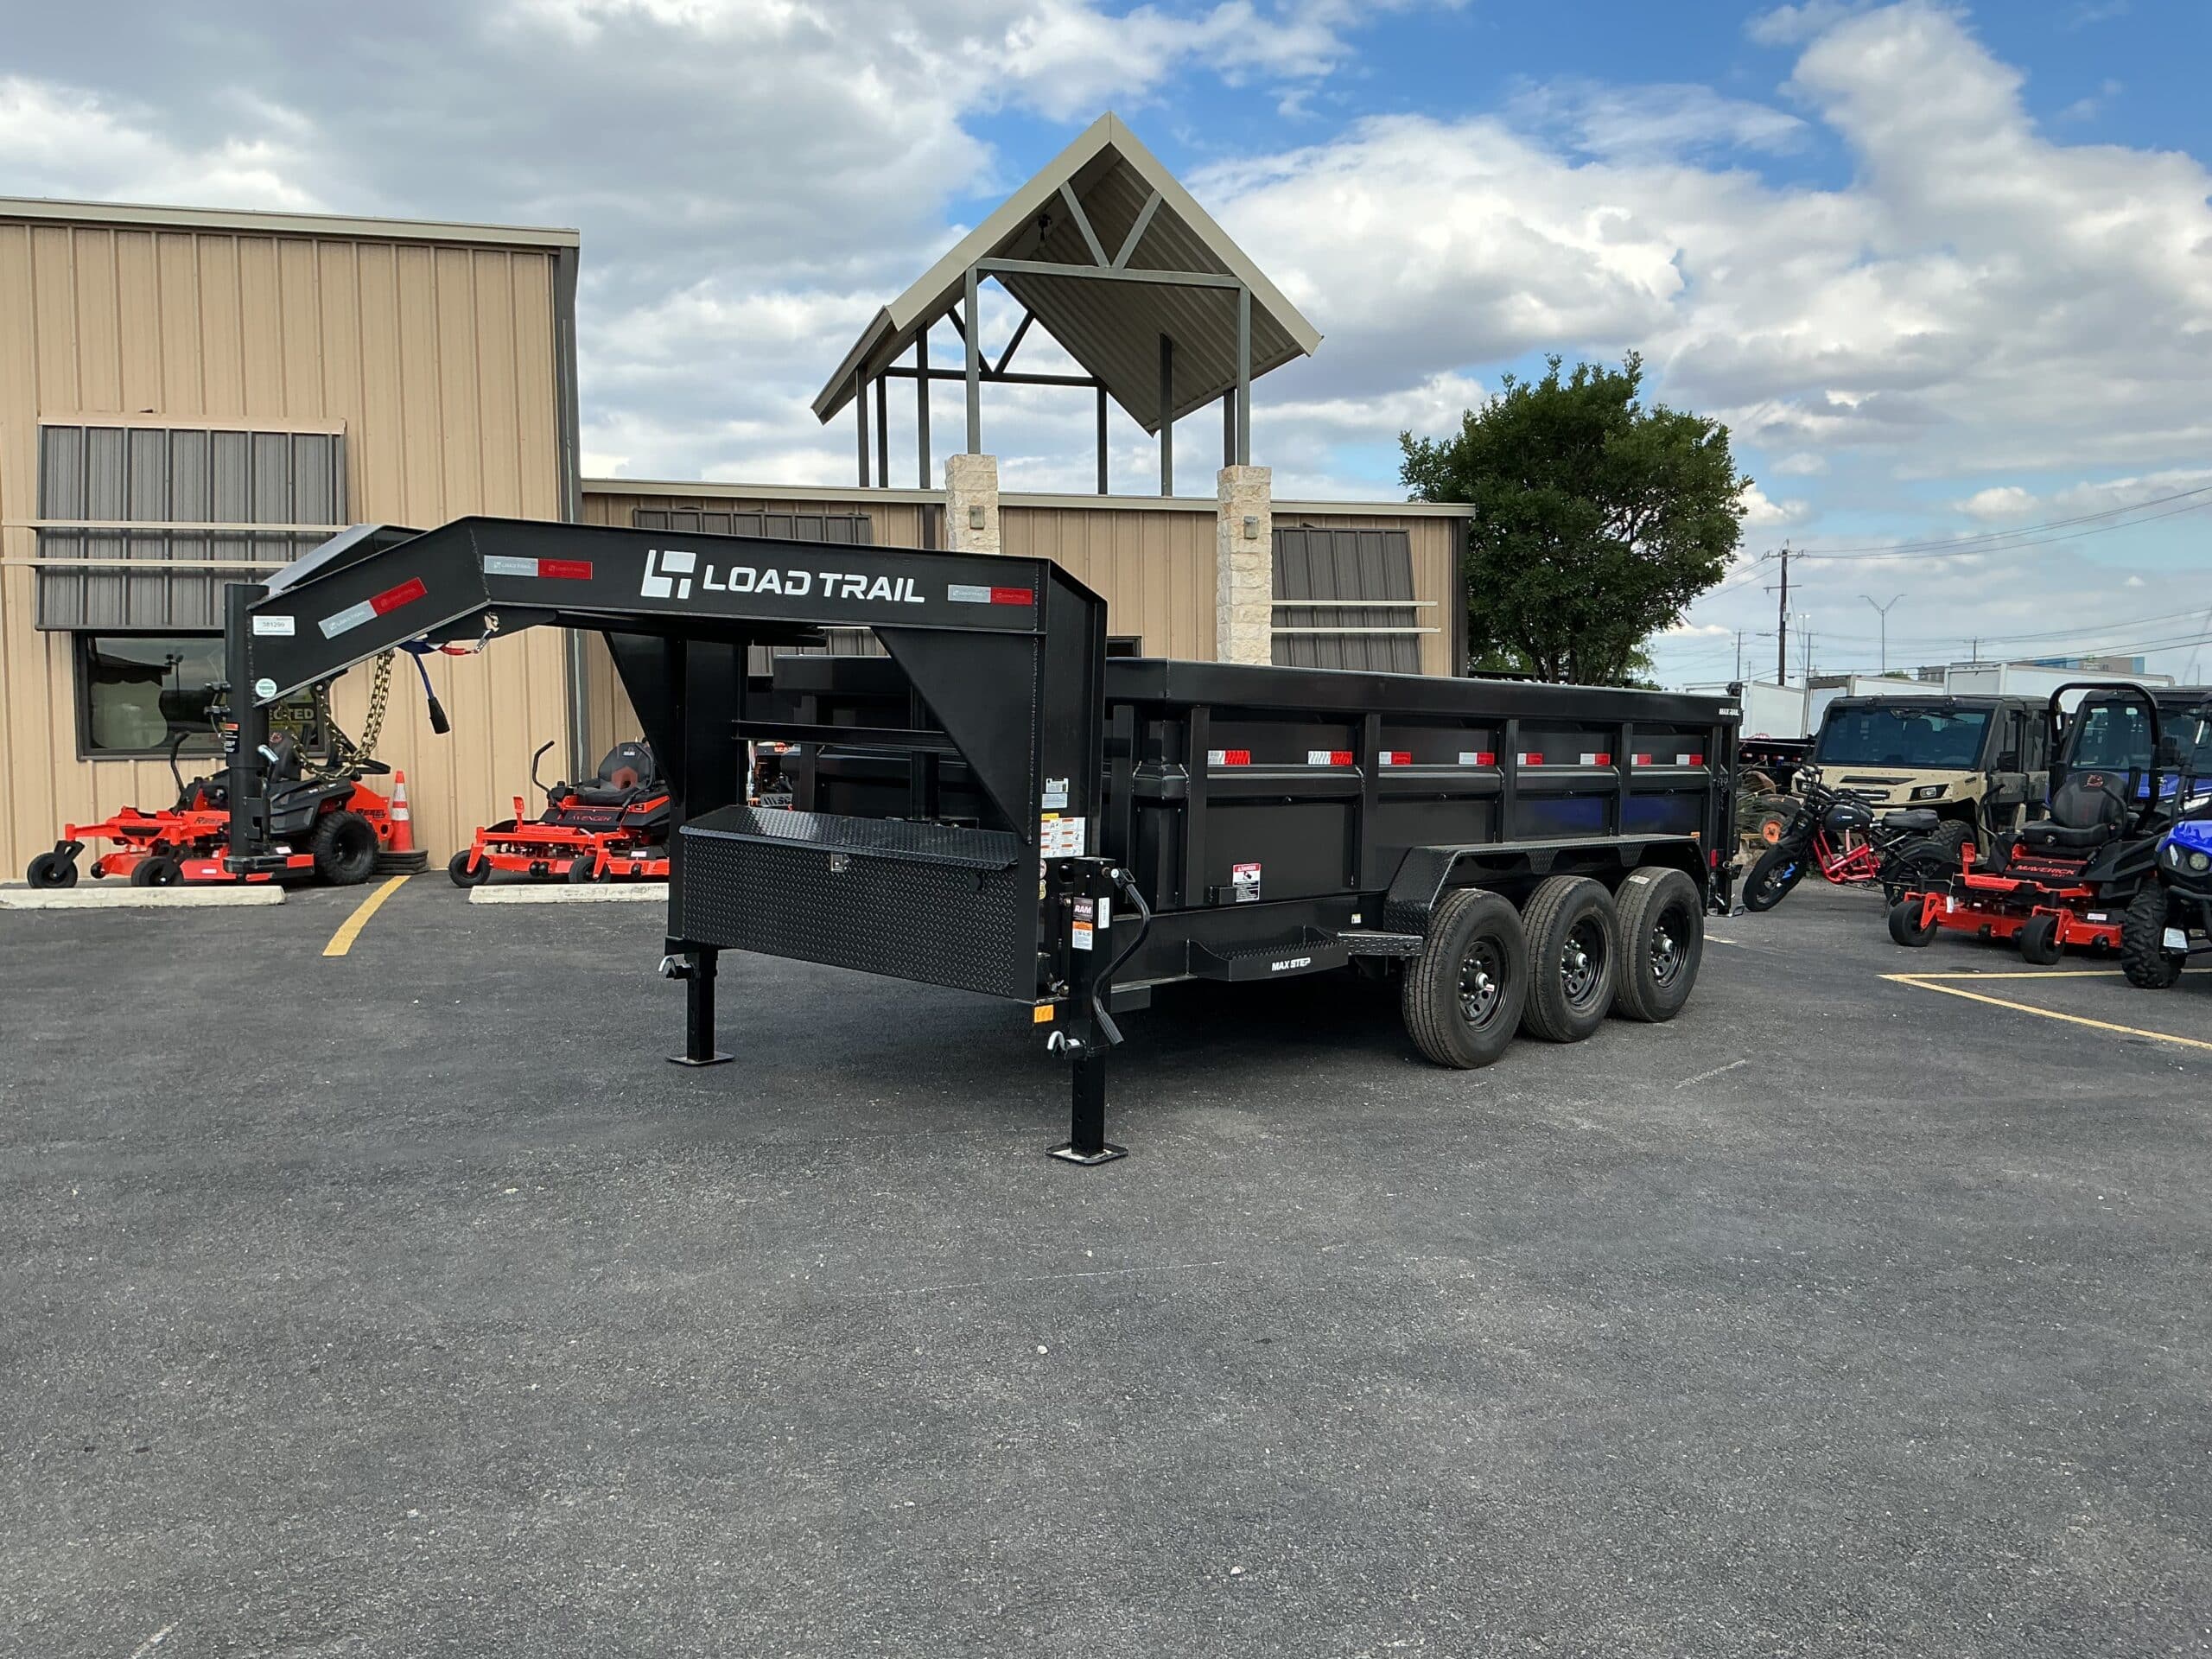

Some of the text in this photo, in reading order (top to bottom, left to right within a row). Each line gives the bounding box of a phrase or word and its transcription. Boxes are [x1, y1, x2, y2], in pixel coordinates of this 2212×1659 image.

[702, 564, 925, 603] LOAD TRAIL
[2016, 865, 2075, 875] MAVERICK
[1074, 905, 1092, 914] RAM
[1271, 957, 1312, 972] MAX STEP
